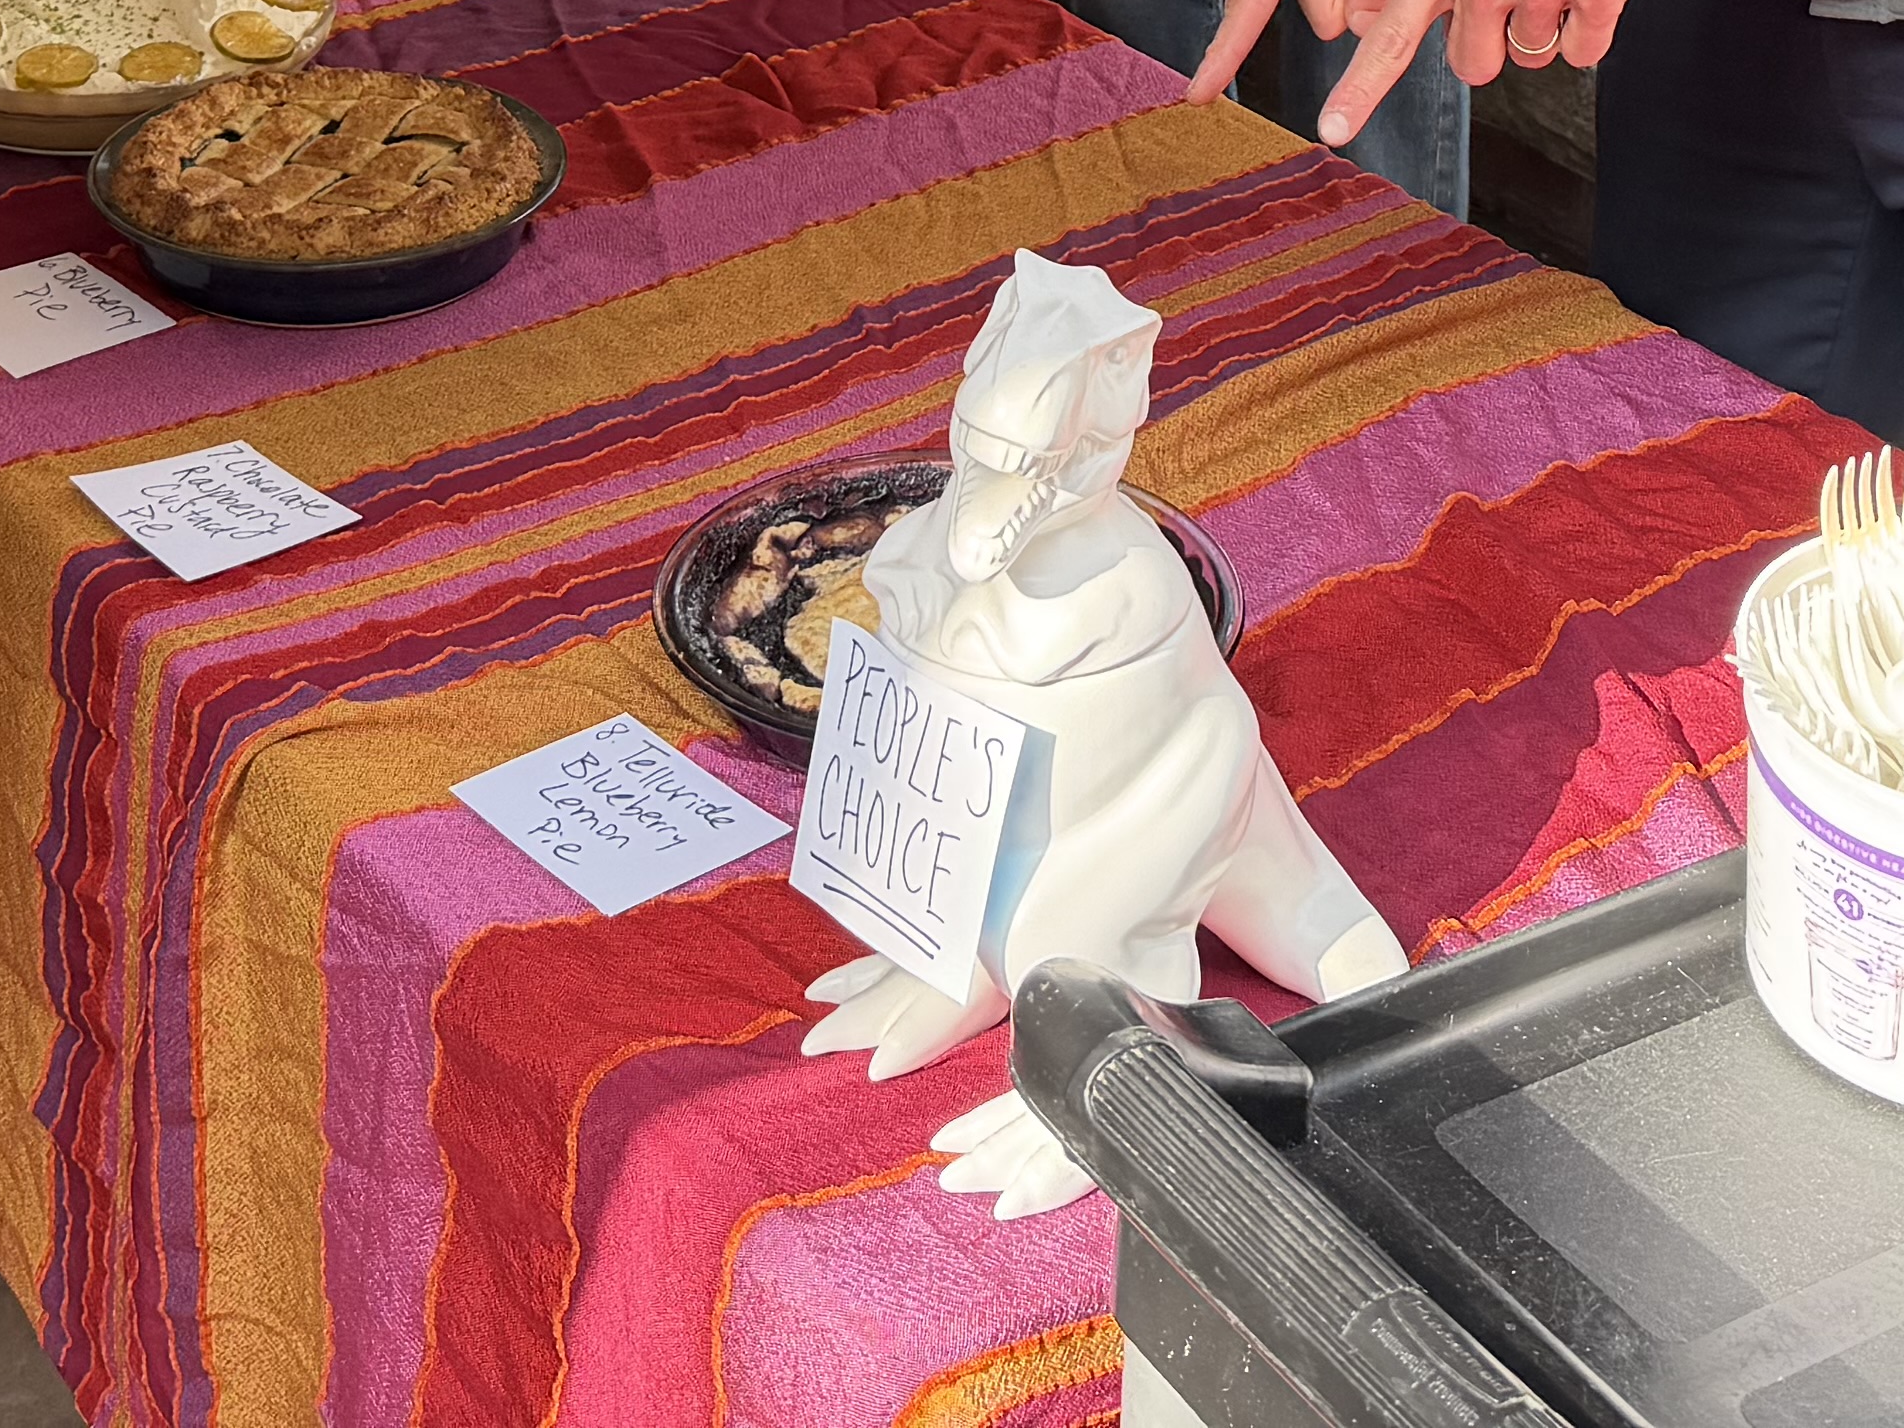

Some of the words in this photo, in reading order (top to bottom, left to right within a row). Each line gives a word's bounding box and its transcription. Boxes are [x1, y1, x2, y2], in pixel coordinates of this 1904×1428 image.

[13, 282, 69, 321] Pie
[53, 265, 142, 332] Blueberry
[117, 504, 174, 539] Pie
[171, 465, 291, 540] Raspberry
[224, 459, 332, 520] Chocolate
[836, 638, 1004, 818] PEOPLE'S
[538, 782, 631, 849] Lemon
[560, 751, 689, 852] Blueberry
[617, 739, 736, 831] Telluride
[527, 816, 583, 866] Pie
[818, 754, 961, 924] CHOICE
[1836, 893, 1859, 918] 41
